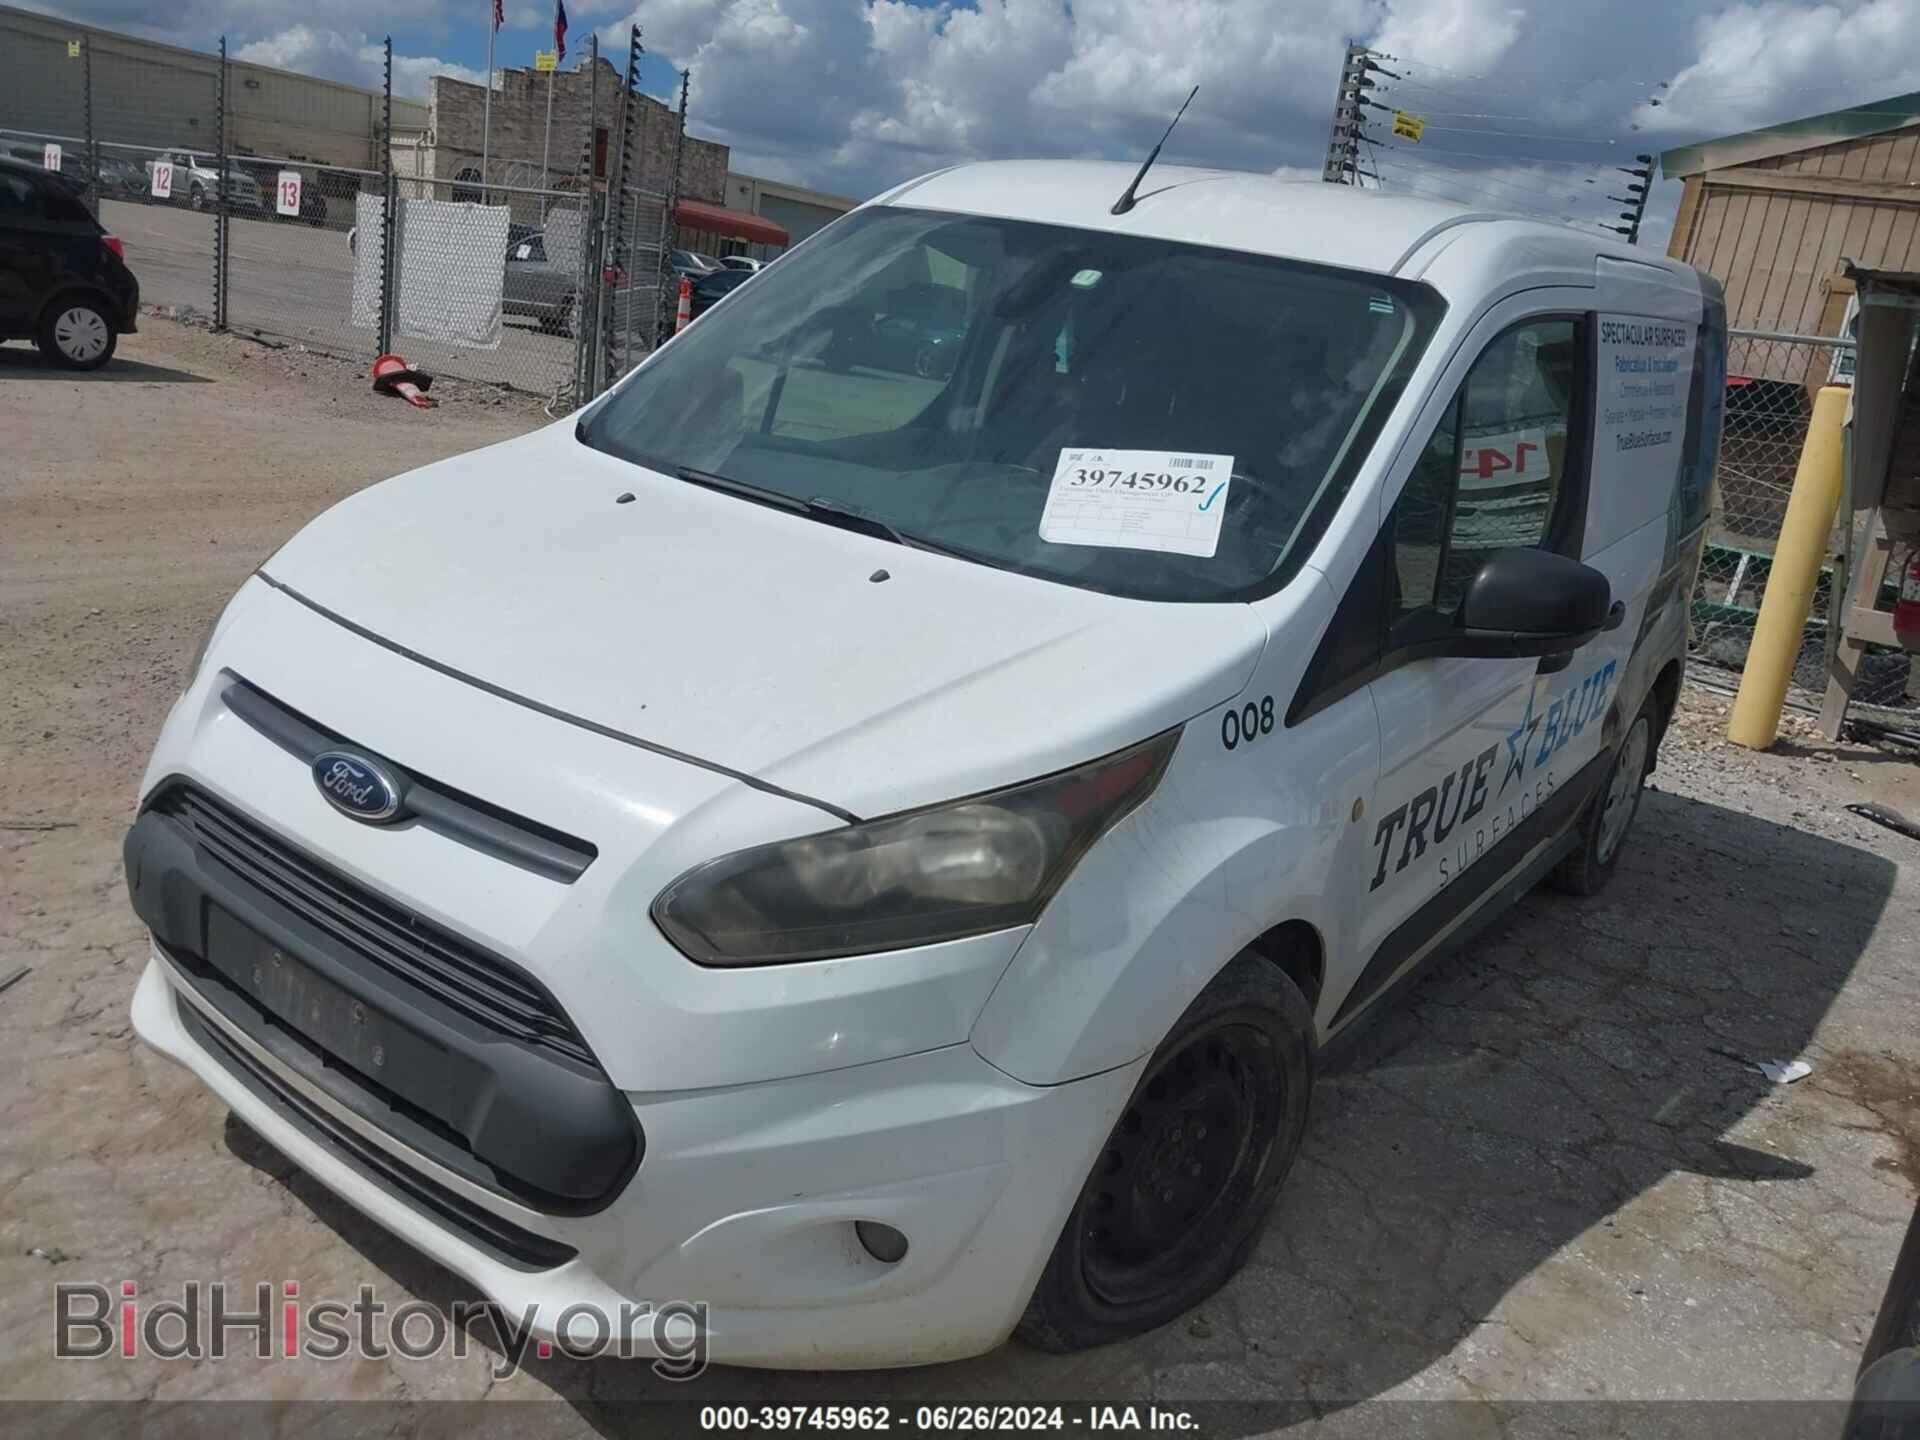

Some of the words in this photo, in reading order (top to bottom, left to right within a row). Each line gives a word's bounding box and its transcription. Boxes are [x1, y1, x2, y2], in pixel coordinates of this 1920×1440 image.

[156, 167, 170, 190] 12
[280, 182, 297, 207] 13
[1601, 322, 1654, 346] SPECTACULAR
[1071, 468, 1206, 494] 39745962
[1222, 695, 1275, 751] 008
[323, 760, 374, 805] Ford
[1369, 742, 1500, 892] TRUE
[1535, 659, 1617, 768] BLUE
[1439, 772, 1555, 887] SURFACES
